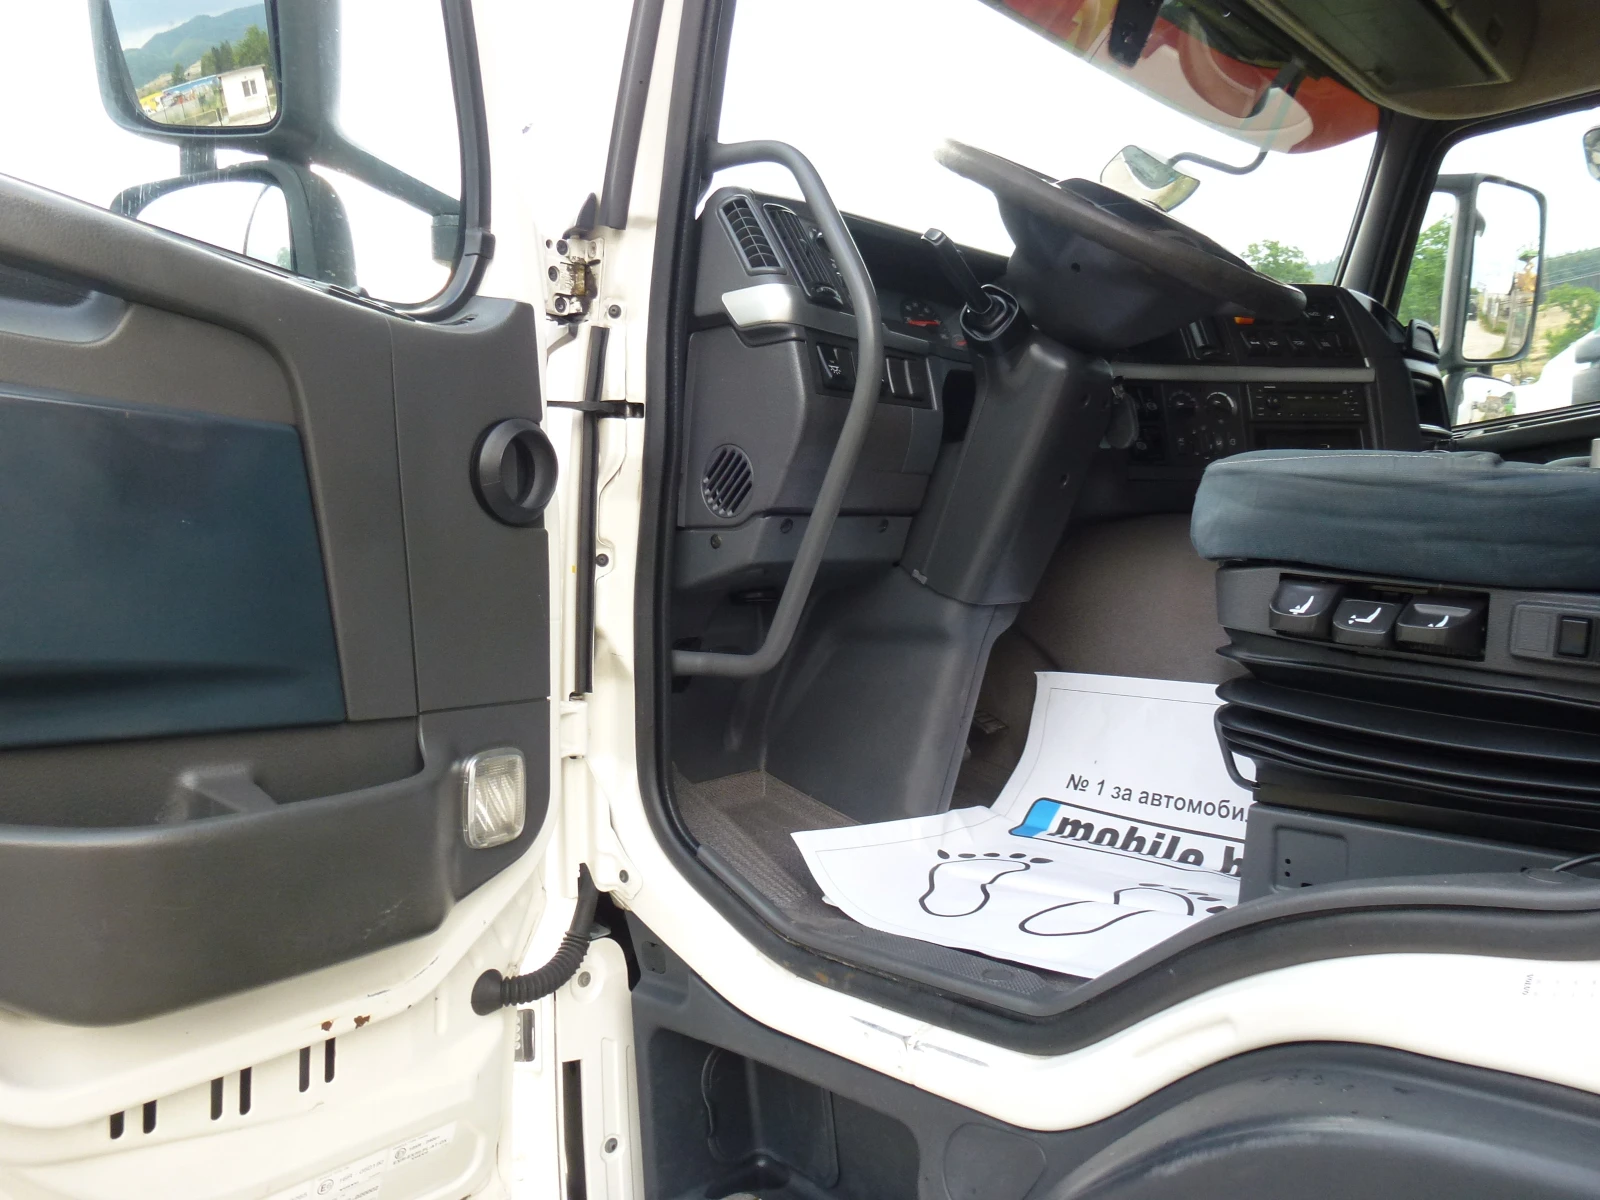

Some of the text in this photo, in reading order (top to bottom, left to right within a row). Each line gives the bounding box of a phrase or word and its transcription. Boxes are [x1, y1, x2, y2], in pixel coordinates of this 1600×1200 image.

[1096, 779, 1106, 796] 1
[1110, 785, 1133, 802] за
[1137, 790, 1248, 823] автомоби
